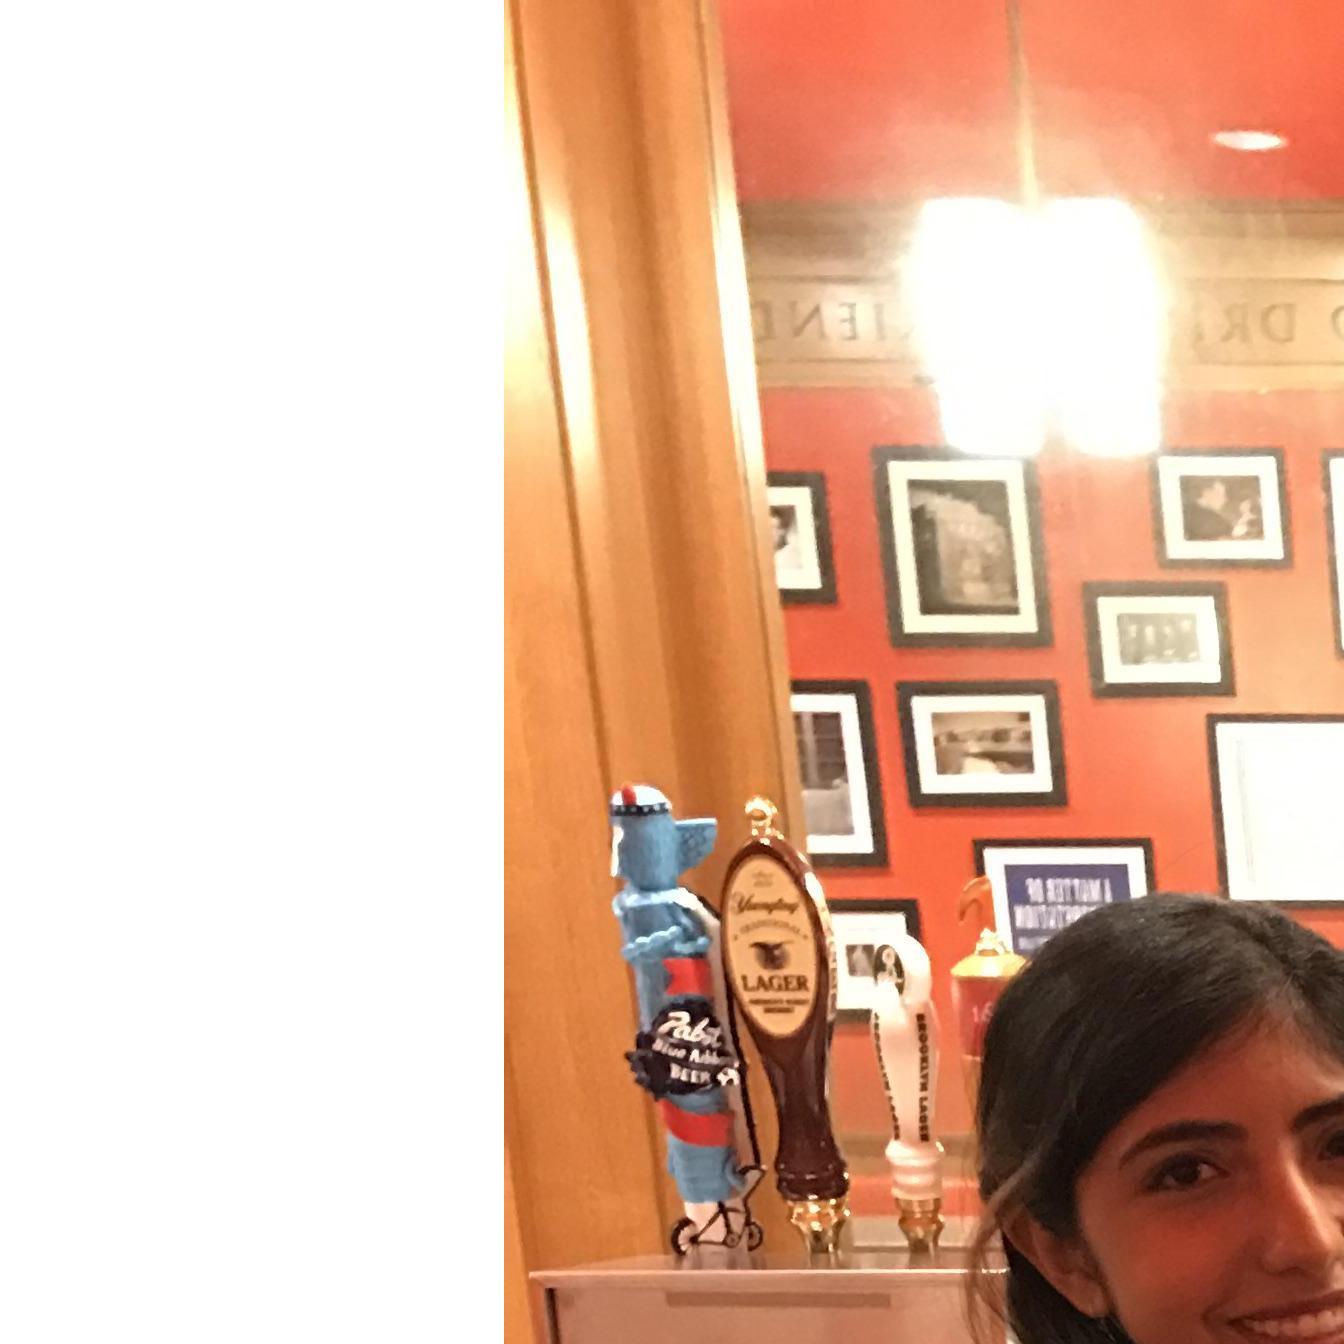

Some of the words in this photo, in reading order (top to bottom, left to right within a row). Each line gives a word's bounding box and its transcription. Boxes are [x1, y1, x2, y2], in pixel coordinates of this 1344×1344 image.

[741, 974, 809, 992] LAGER
[657, 1010, 722, 1049] Pabst
[670, 1062, 711, 1084] BEER
